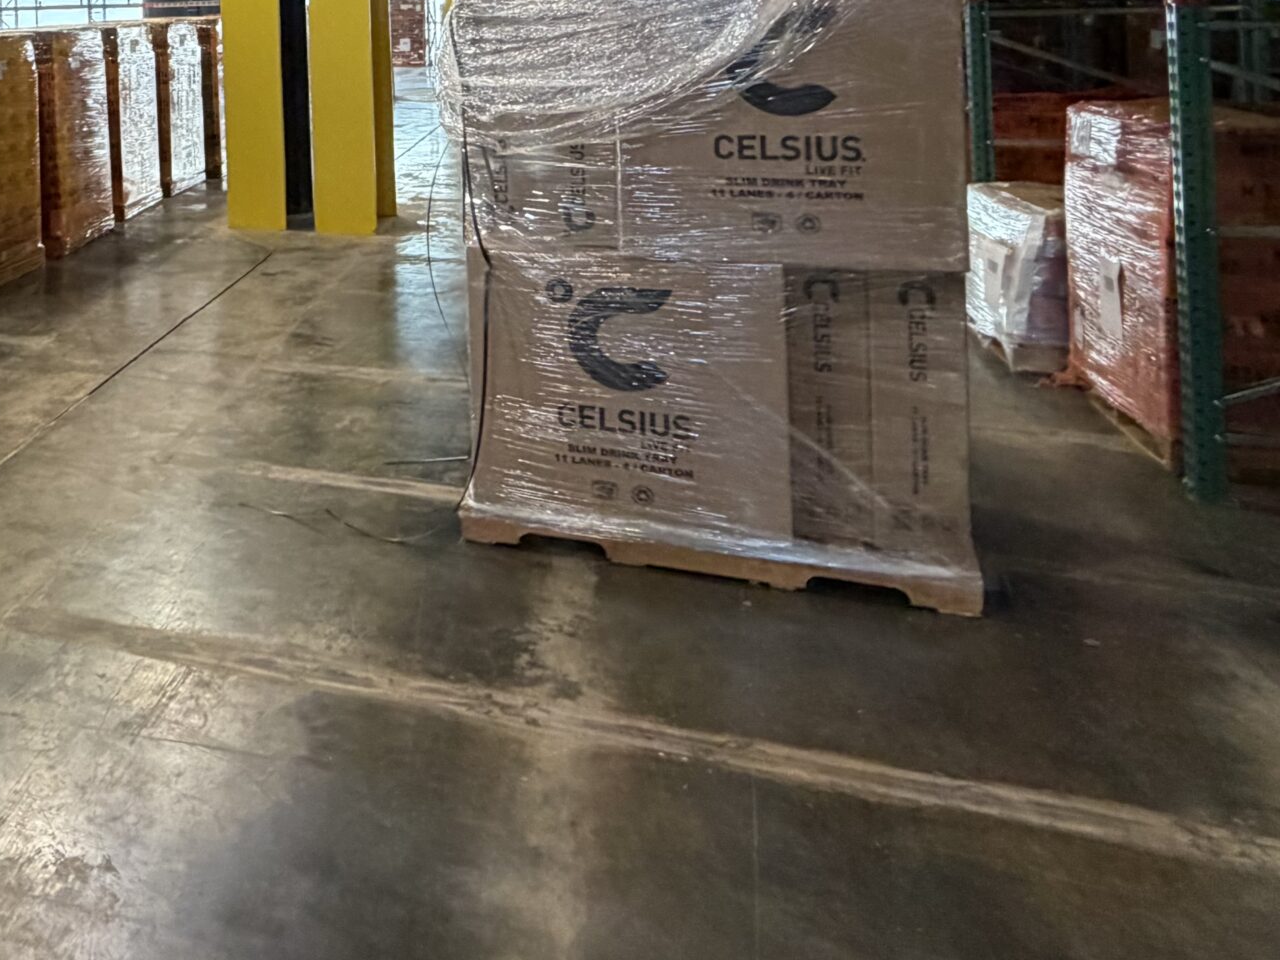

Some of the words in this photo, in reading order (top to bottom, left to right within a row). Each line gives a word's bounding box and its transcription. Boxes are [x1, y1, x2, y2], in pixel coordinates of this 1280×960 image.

[713, 134, 863, 162] CELSIUS
[805, 165, 835, 176] LIVE
[840, 165, 863, 176] FIT
[908, 308, 928, 382] CELSIUS
[558, 402, 694, 440] CELSIUS
